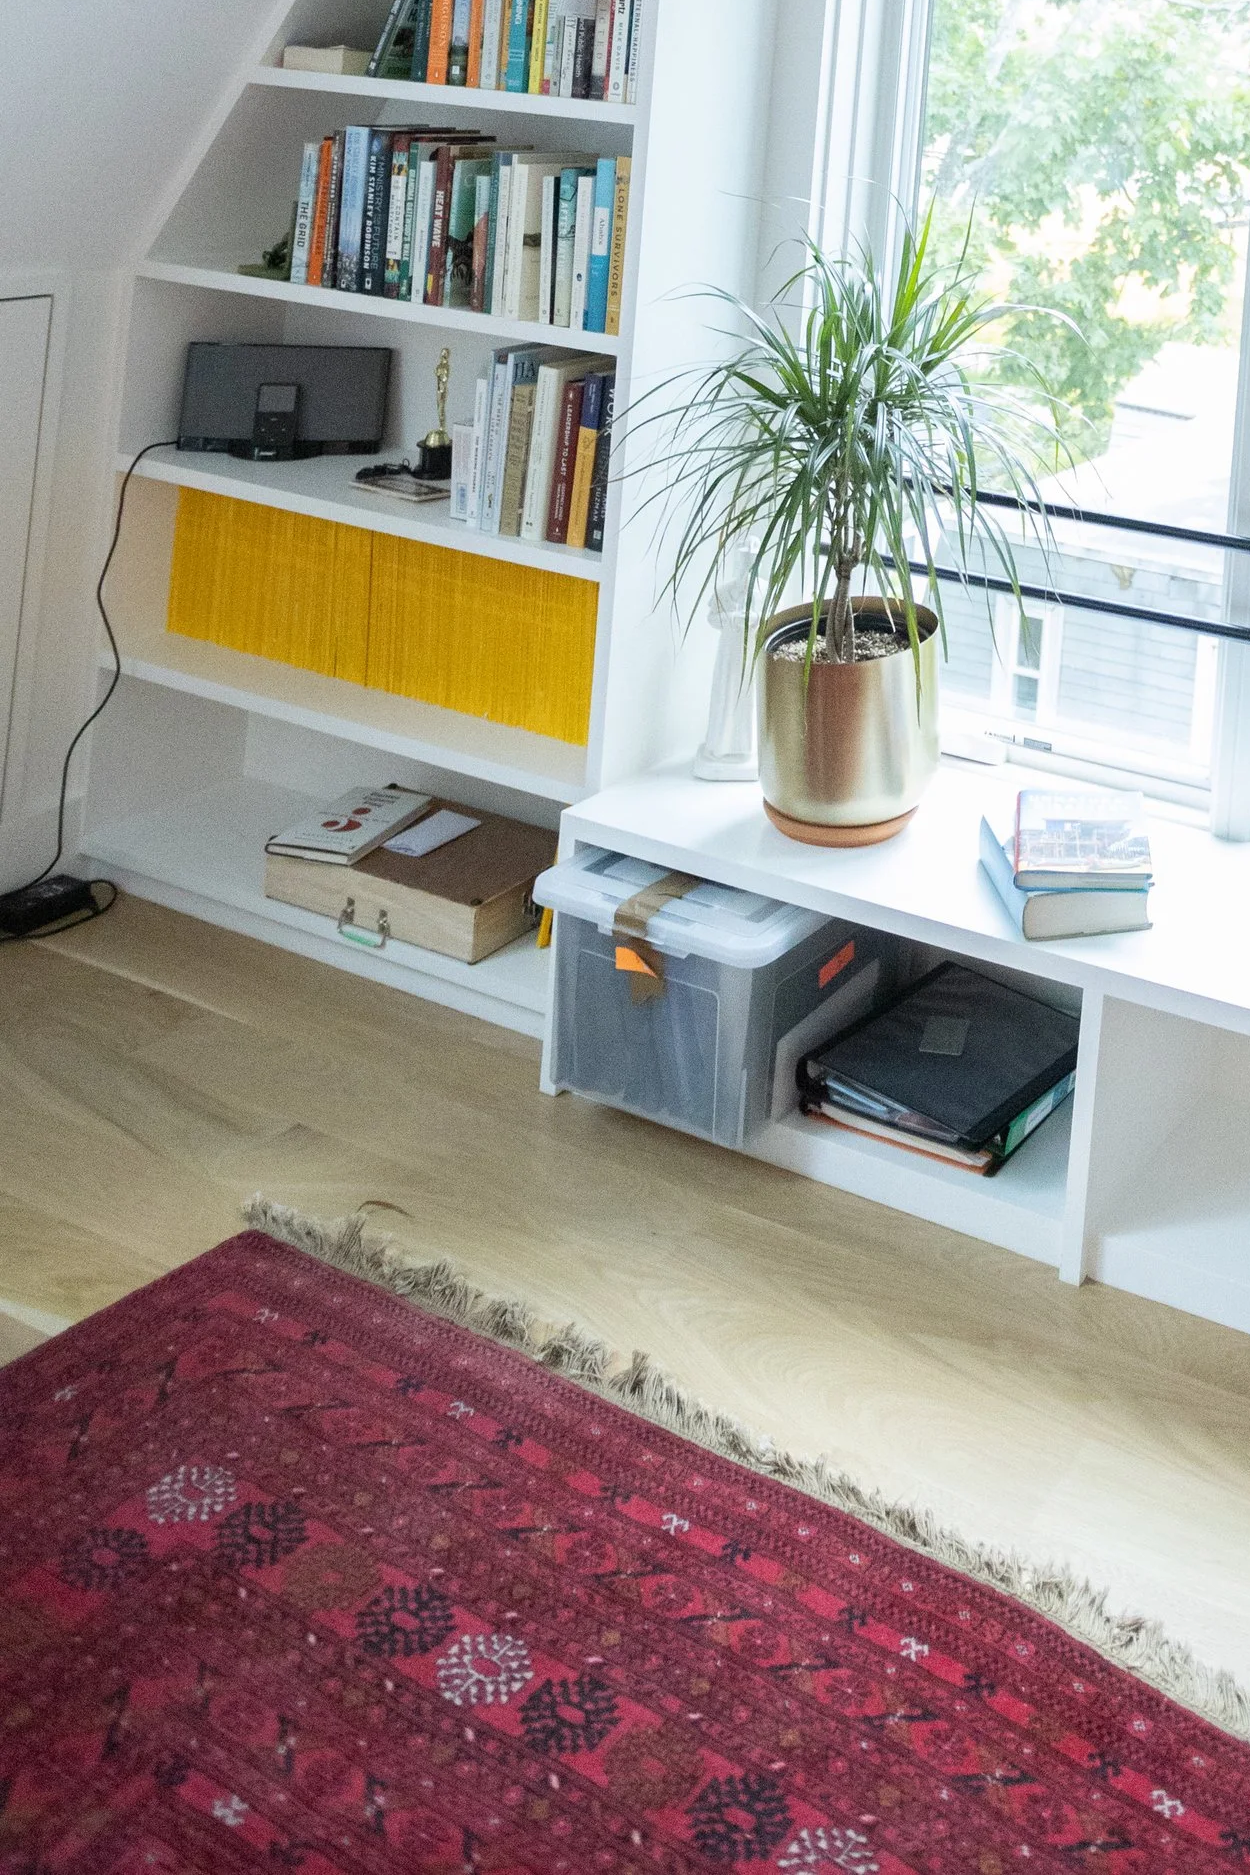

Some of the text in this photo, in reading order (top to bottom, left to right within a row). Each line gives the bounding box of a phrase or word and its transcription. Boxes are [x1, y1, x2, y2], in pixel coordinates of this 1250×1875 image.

[366, 177, 376, 217] STANLEY
[432, 190, 445, 248] HEAT WAVE
[297, 202, 309, 247] THE GRID
[363, 220, 373, 269] ROBINSON
[610, 188, 625, 297] LONE SURVIVORS
[371, 227, 381, 270] FUTURE
[592, 487, 601, 522] SUZMAN
